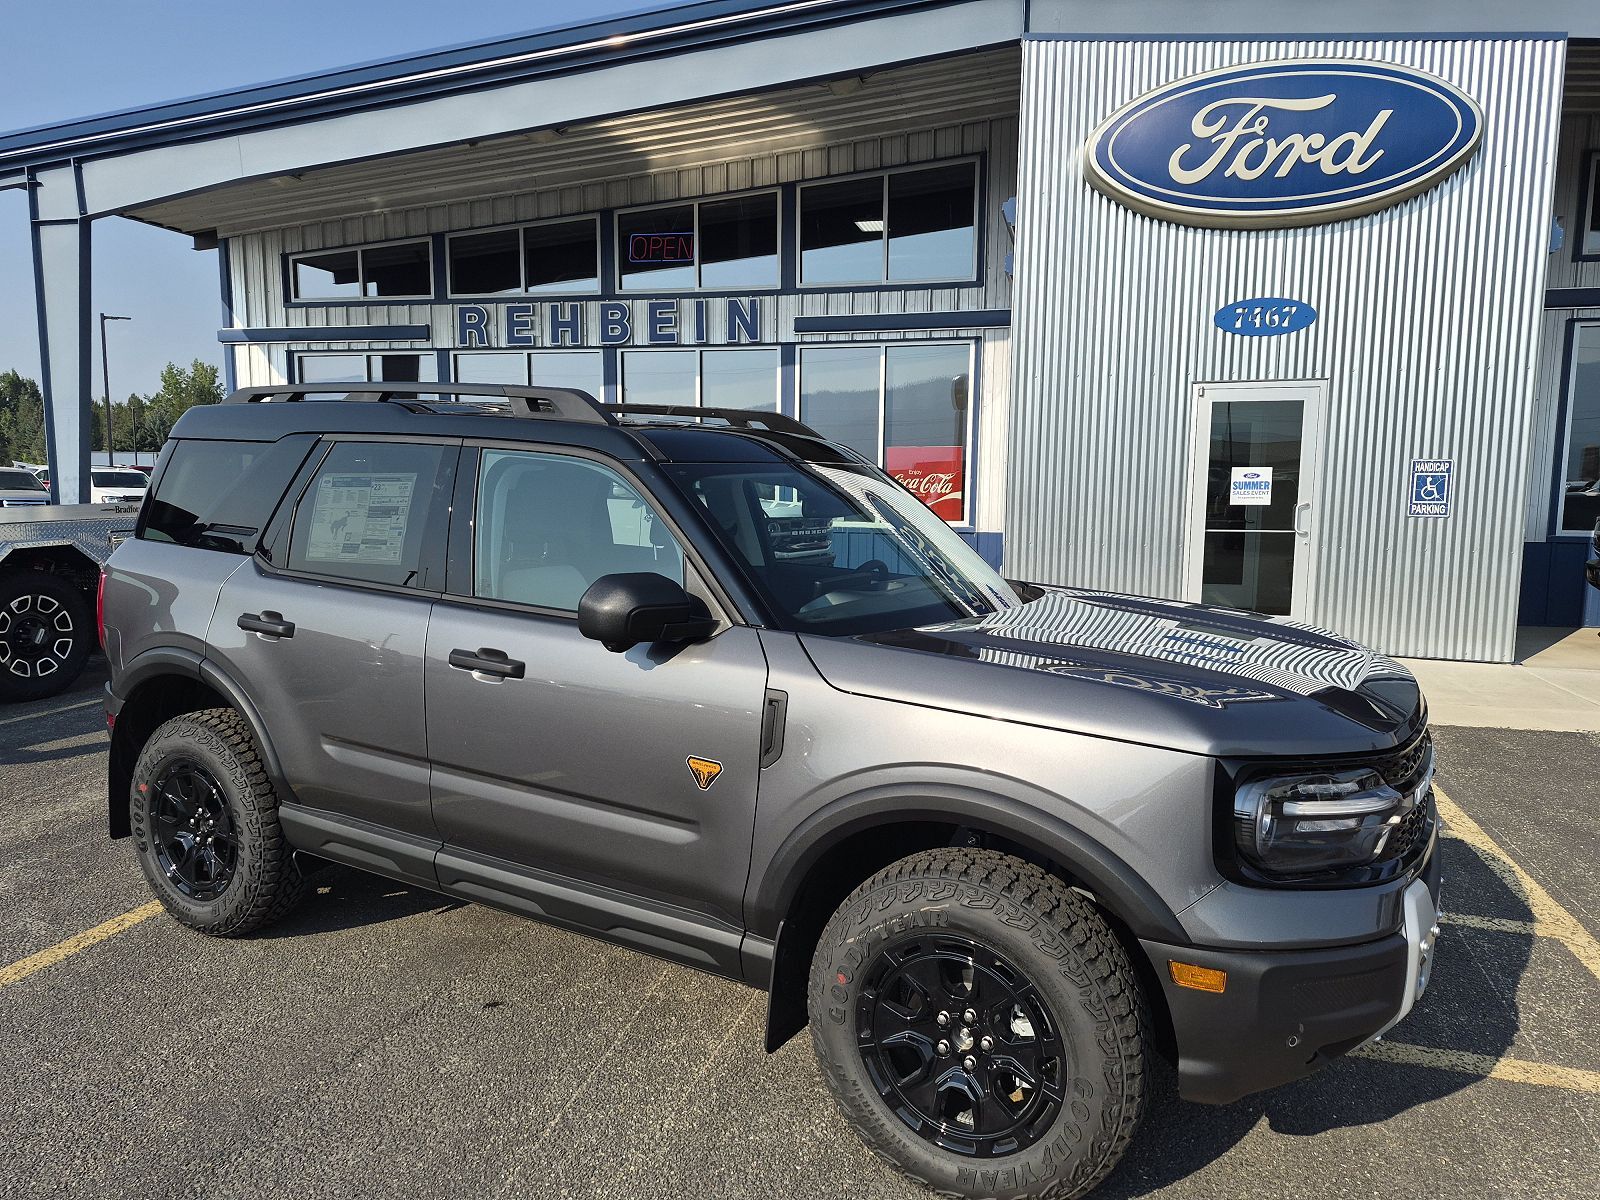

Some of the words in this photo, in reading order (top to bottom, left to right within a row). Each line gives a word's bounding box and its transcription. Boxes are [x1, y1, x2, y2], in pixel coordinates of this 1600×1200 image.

[1168, 93, 1394, 185] Ford
[632, 236, 694, 259] OPEN
[457, 298, 760, 347] REHBEIN
[1234, 306, 1298, 328] 7467
[1415, 462, 1450, 472] HANDICAP
[1232, 480, 1271, 491] SUMMER
[1411, 504, 1446, 514] PARKING
